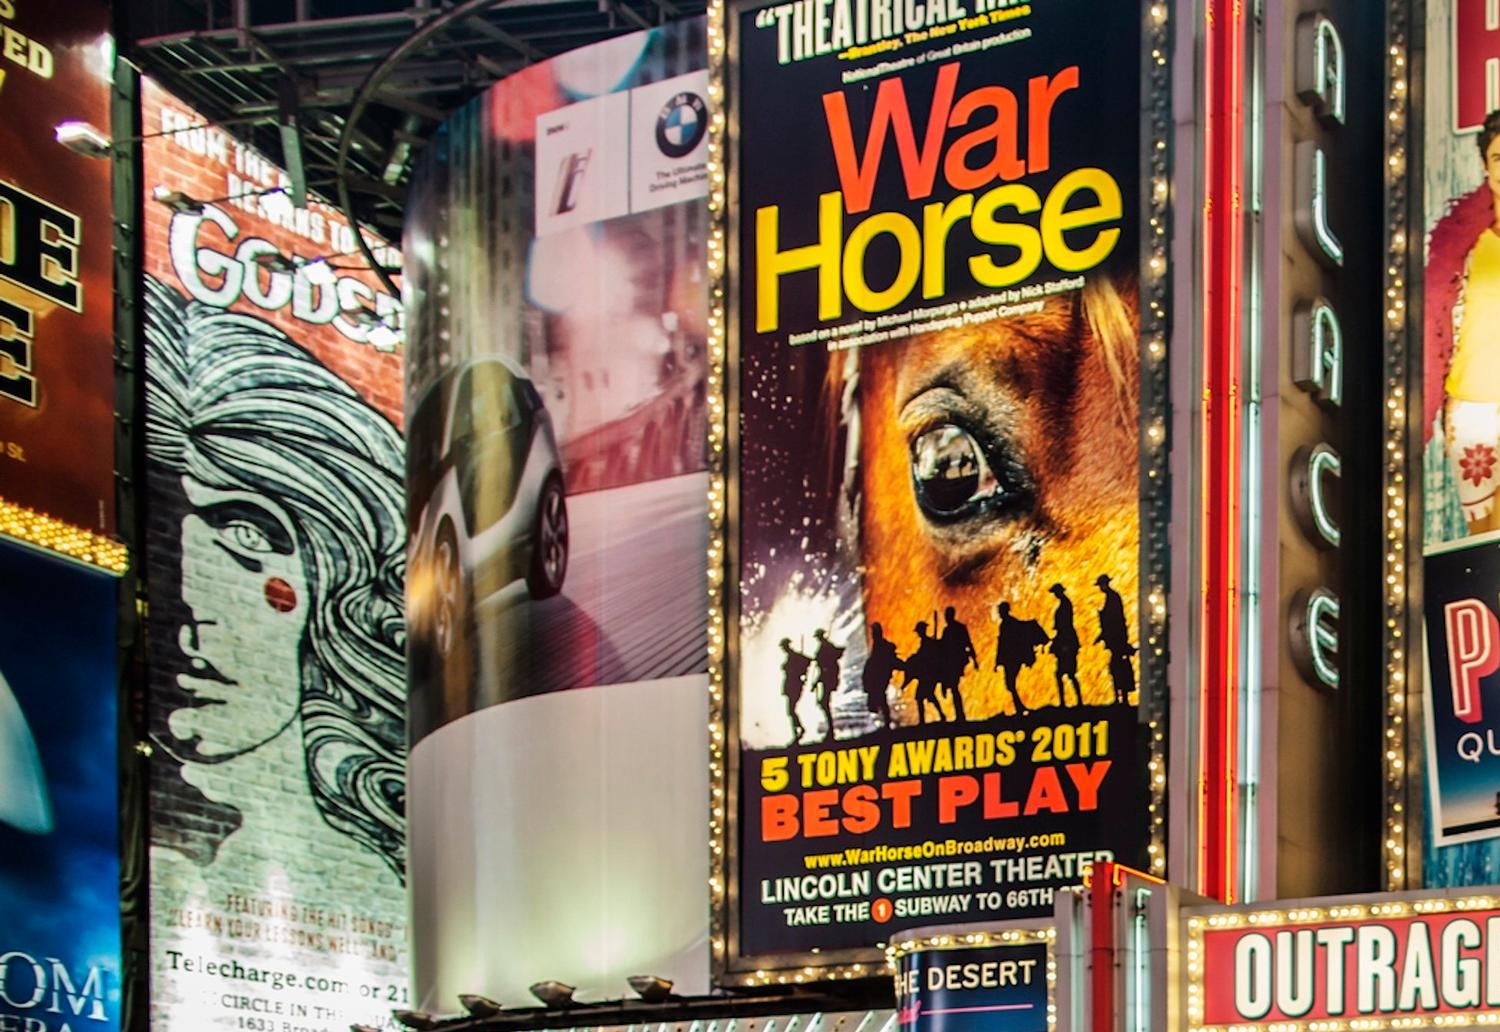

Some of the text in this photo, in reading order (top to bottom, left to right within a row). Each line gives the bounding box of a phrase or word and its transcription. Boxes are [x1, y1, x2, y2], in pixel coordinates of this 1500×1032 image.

[823, 63, 1079, 214] War
[755, 167, 1122, 333] Horse
[760, 756, 789, 792] 5
[797, 745, 880, 788] TONY
[1031, 720, 1109, 763] 2011
[761, 760, 1113, 842] BEST PLAY
[804, 831, 1066, 869] www.WarHorseOnBroadway.com
[761, 858, 983, 905] LINCOLN CENTER
[784, 905, 831, 927] TAKE
[833, 901, 870, 924] THE
[894, 892, 971, 918] SUBWAY
[976, 889, 1002, 912] TO
[1006, 886, 1054, 909] 66TH
[928, 959, 1037, 991] DESERT
[221, 994, 284, 1015] CIRCLE
[291, 1003, 307, 1018] IN
[238, 1016, 275, 1031] 1633
